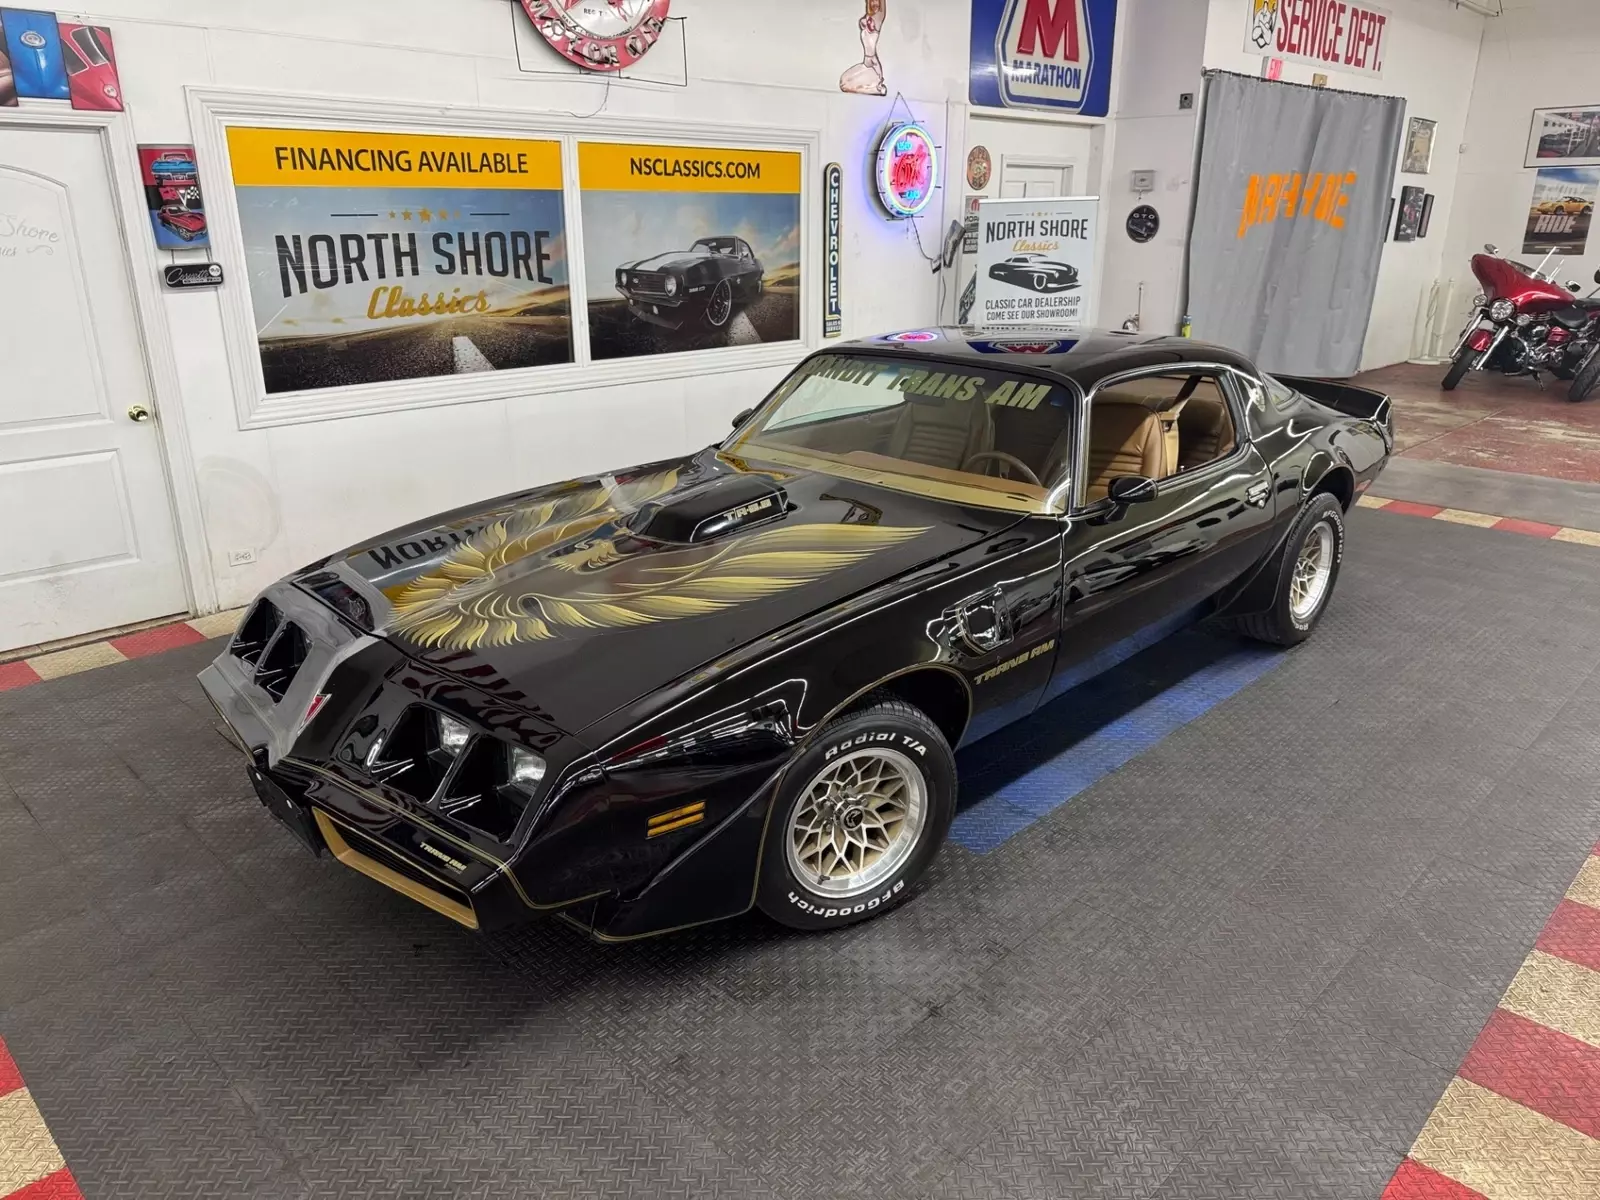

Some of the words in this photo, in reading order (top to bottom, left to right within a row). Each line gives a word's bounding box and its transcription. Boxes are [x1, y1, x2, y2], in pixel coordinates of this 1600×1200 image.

[1276, 0, 1346, 63] SERVICE
[1344, 7, 1386, 72] DEPT.
[1011, 60, 1082, 90] MARATHON
[274, 146, 412, 173] FINANCING
[418, 151, 529, 174] AVAILABLE
[630, 157, 761, 179] NSCLASSICS.COM
[985, 220, 1035, 244] NORTH
[1039, 218, 1089, 240] SHORE
[1534, 214, 1577, 233] RIDE
[829, 172, 840, 312] CHEVROLET
[1012, 240, 1060, 252] Classics
[274, 232, 420, 298] NORTH
[432, 230, 554, 285] SHORE
[366, 285, 492, 319] Classics
[985, 299, 1015, 310] CLASSIC
[1017, 298, 1033, 308] CAR
[1034, 296, 1081, 308] DEALERSHIP
[986, 311, 1005, 321] COME
[1007, 310, 1020, 319] SEE
[1021, 310, 1035, 319] OUR
[1036, 308, 1078, 318] SHOWROOM!
[886, 367, 986, 401] TRANS
[984, 381, 1052, 411] AM
[974, 652, 1030, 685] TRANS
[1030, 639, 1056, 659] AM
[824, 732, 897, 760] Radial
[902, 735, 928, 758] T/A
[787, 879, 905, 918] BFGoodrich
